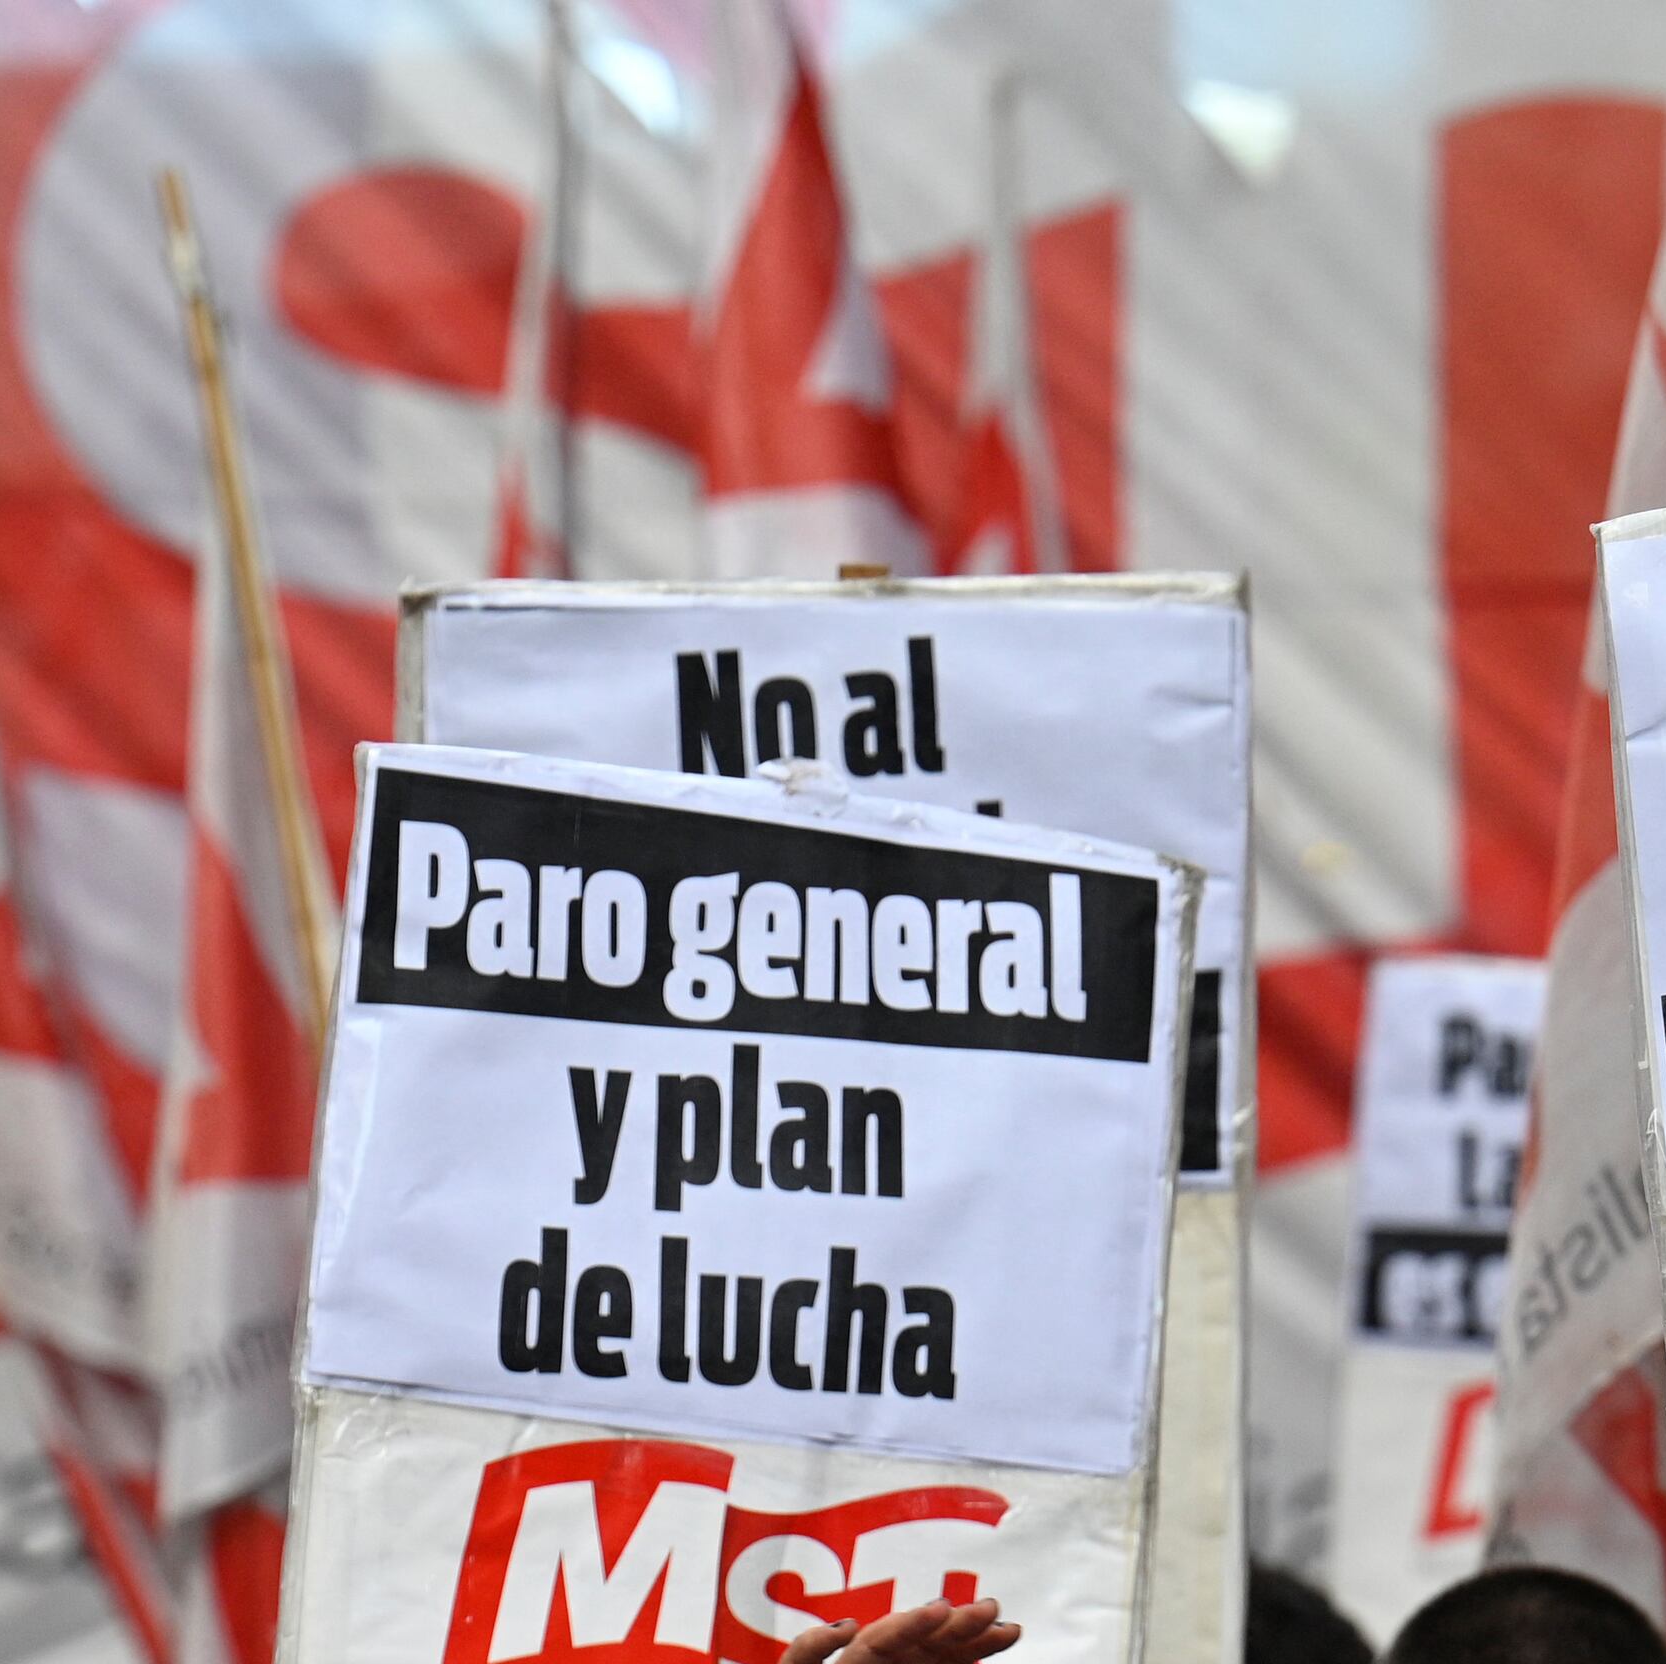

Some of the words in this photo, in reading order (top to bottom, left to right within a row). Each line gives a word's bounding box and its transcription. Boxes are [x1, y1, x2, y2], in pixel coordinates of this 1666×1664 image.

[676, 649, 817, 779] No
[842, 635, 947, 777] al
[393, 820, 645, 986] Paro
[662, 872, 1088, 1023] general
[568, 1066, 632, 1205] y
[653, 1044, 904, 1212] plan
[498, 1227, 633, 1379] de
[656, 1237, 958, 1401] lucha
